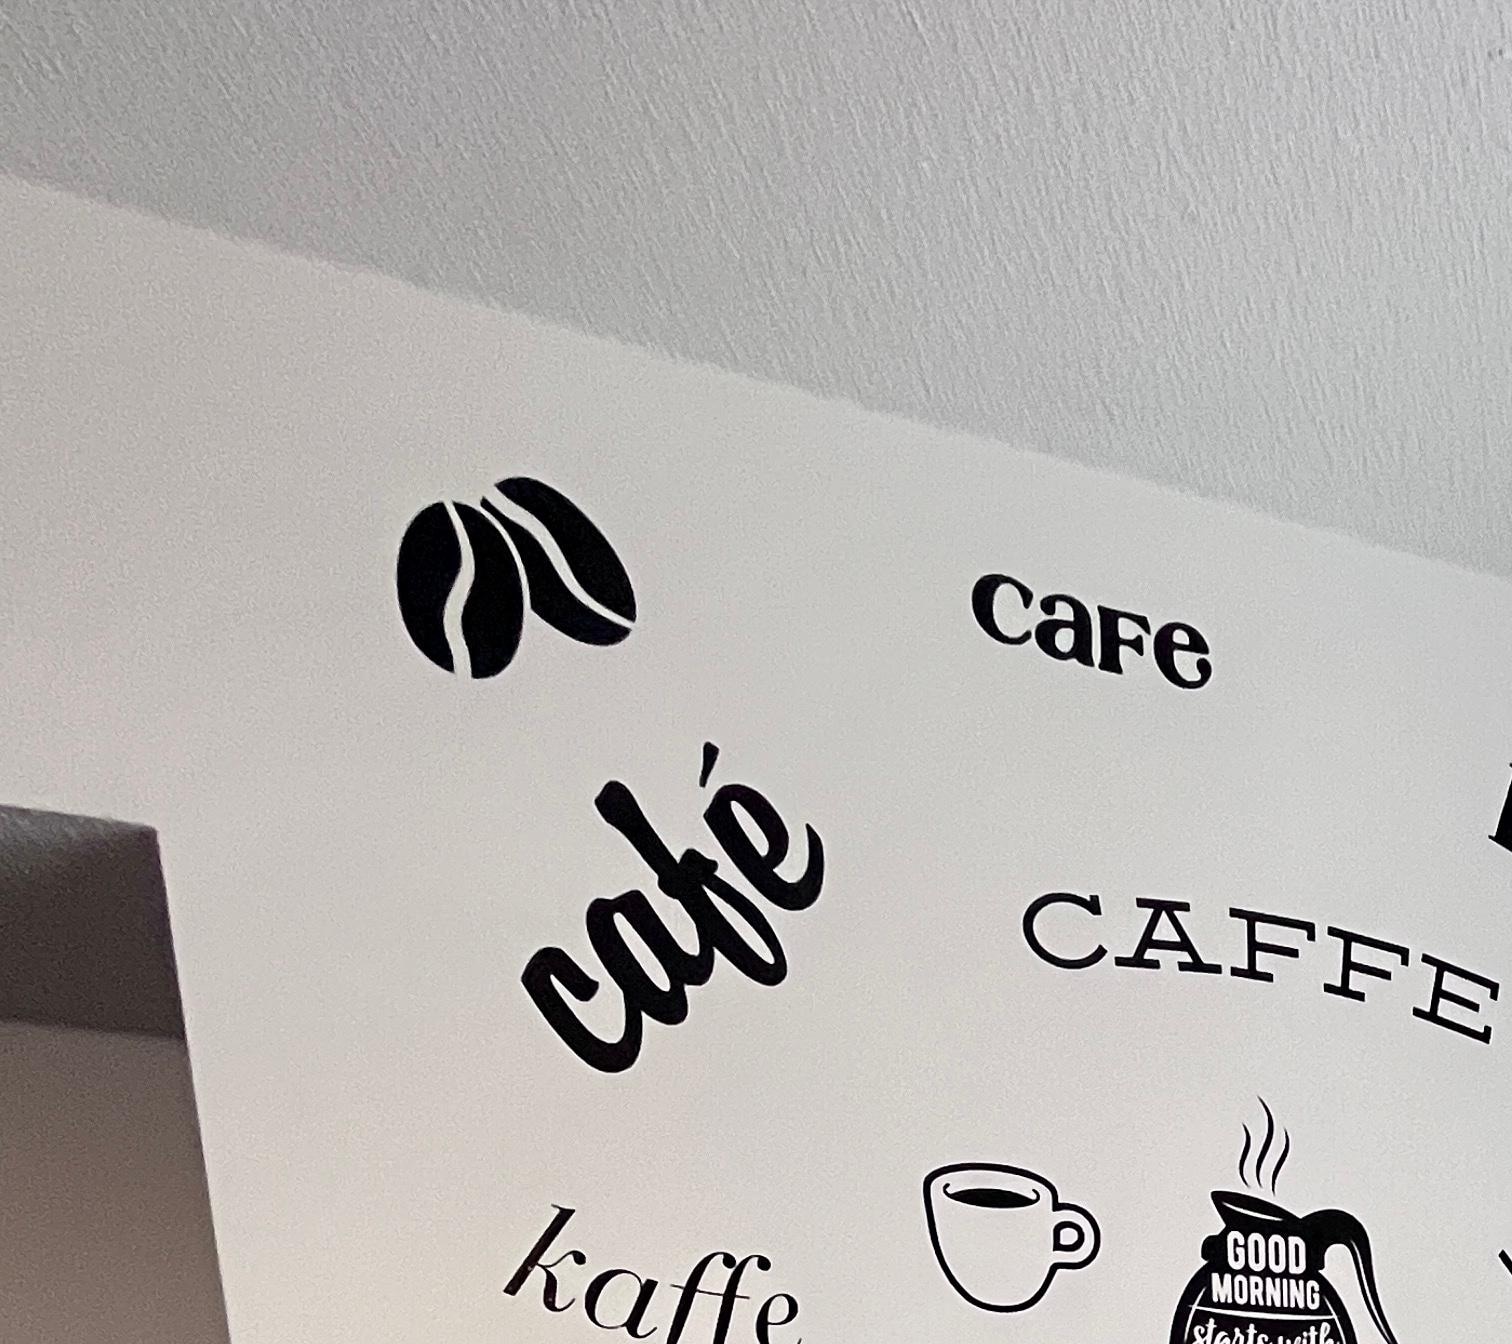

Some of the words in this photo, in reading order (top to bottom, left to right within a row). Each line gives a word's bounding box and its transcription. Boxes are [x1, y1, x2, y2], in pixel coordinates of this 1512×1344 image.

[520, 741, 825, 1074] café
[1022, 892, 1501, 1045] CAFFE
[1210, 1272, 1321, 1311] MORNING
[1226, 1230, 1307, 1275] GOOD
